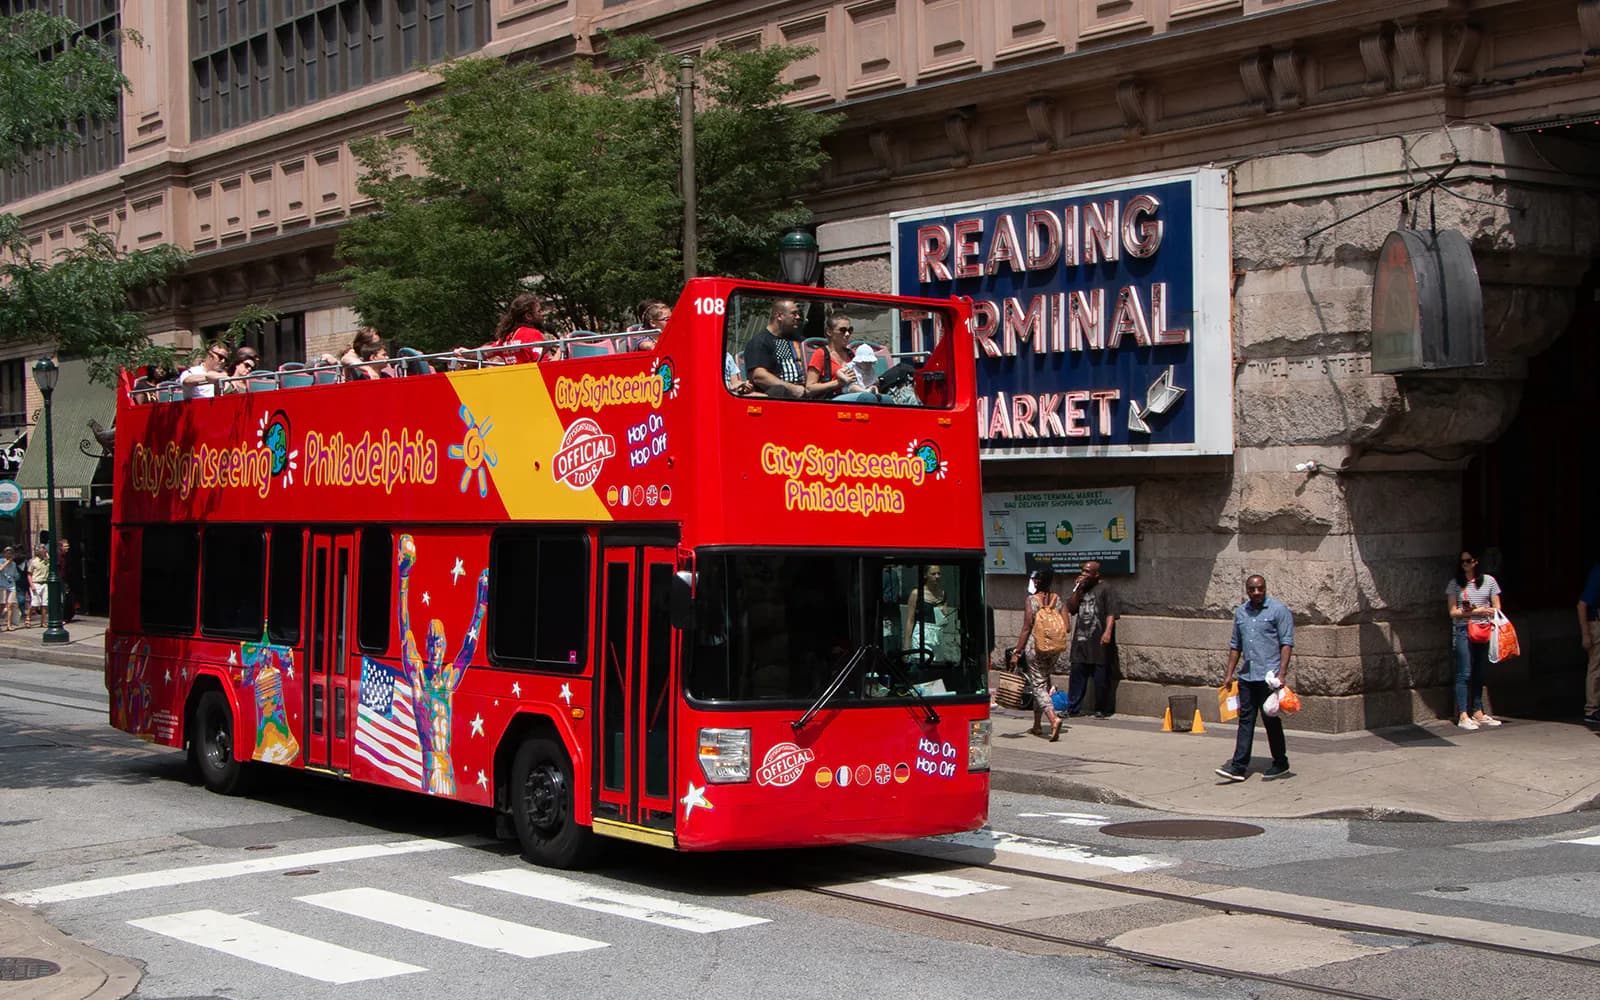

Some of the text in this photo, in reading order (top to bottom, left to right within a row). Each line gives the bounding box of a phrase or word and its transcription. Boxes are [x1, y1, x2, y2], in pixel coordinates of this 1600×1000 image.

[917, 194, 1164, 284] READING
[694, 297, 725, 315] 108
[627, 414, 663, 444] Hop On
[303, 427, 438, 495] Philadelphia
[558, 438, 612, 475] OFFICIAL
[630, 432, 667, 467] Hop Off
[574, 464, 599, 485] TOUR
[785, 478, 905, 517] Philadelphia
[1018, 500, 1050, 509] DELIVERY
[1086, 498, 1113, 507] SPECIAL
[918, 737, 956, 758] Hop On
[762, 751, 811, 780] OFFICIAL
[779, 767, 801, 782] TOUR
[916, 756, 956, 777] Hop Off
